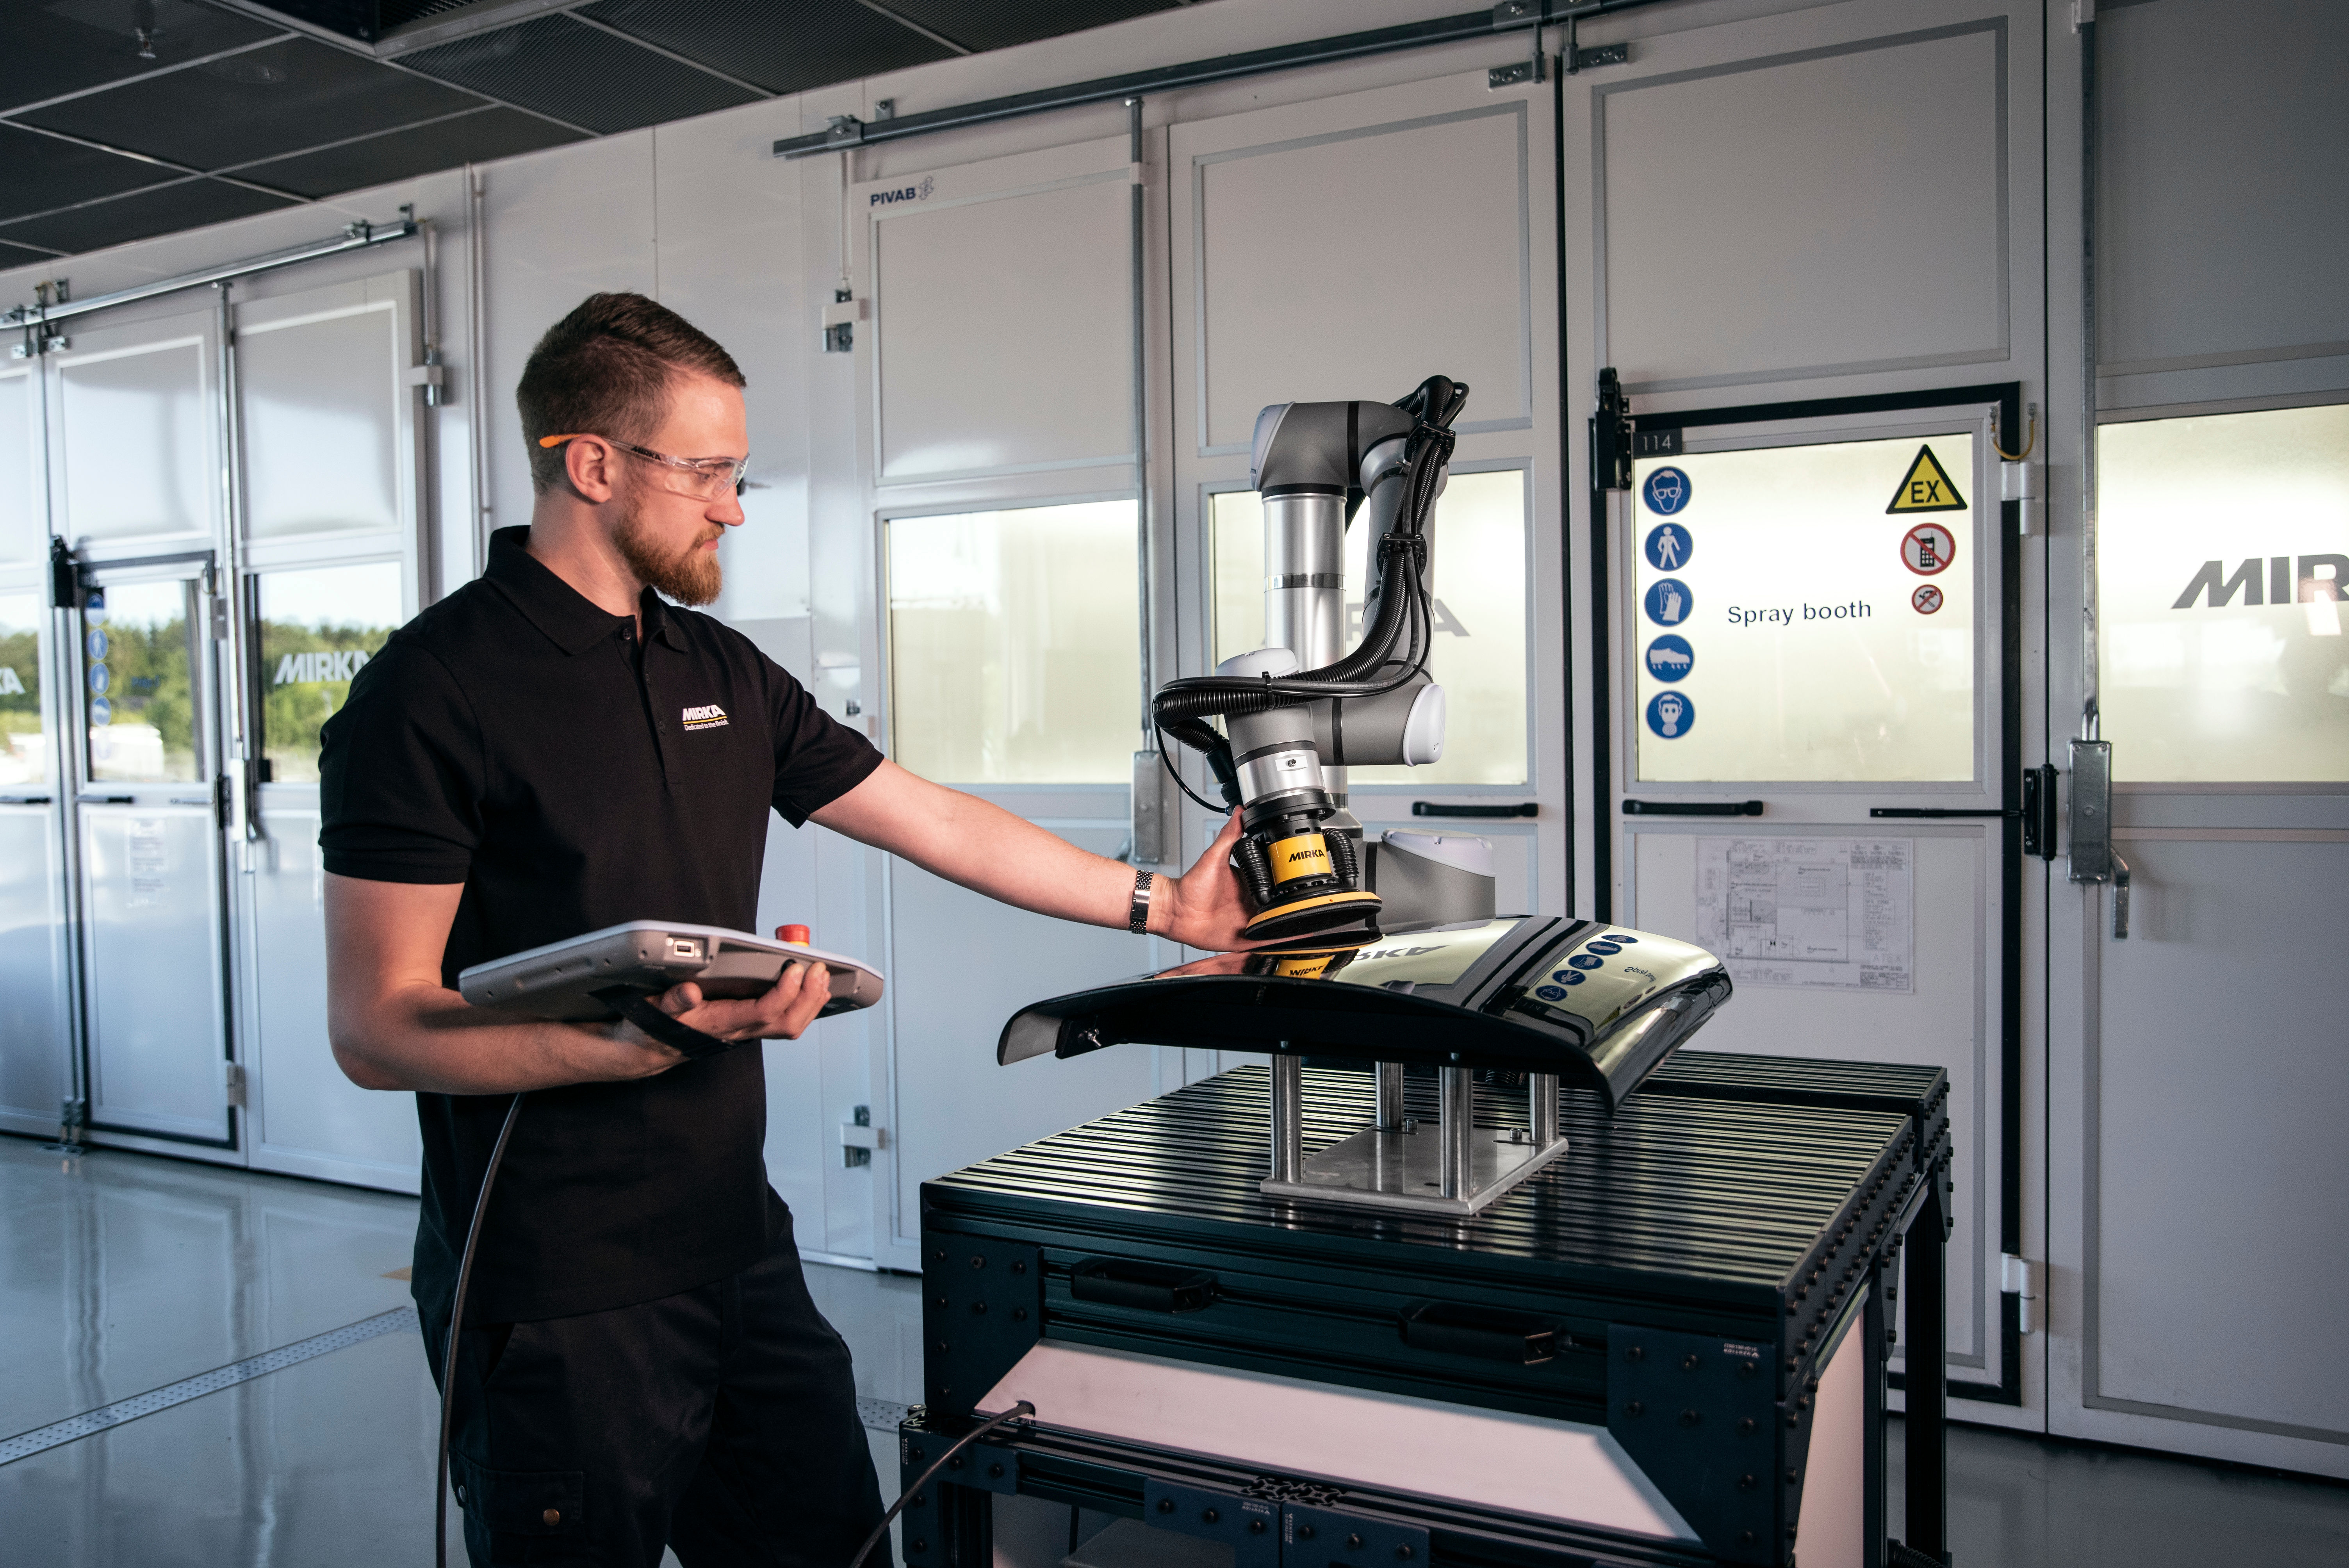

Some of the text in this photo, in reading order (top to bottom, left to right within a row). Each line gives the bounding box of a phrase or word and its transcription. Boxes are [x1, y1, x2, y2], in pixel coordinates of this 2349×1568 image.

[870, 187, 916, 207] PIVAB
[1641, 434, 1672, 450] 114
[631, 446, 661, 461] MIRKA
[1911, 480, 1940, 504] EX
[1727, 600, 1871, 628] Spray booth
[683, 704, 726, 721] MIRKA
[684, 723, 704, 731] Dedicated
[1289, 849, 1325, 863] MIRKA
